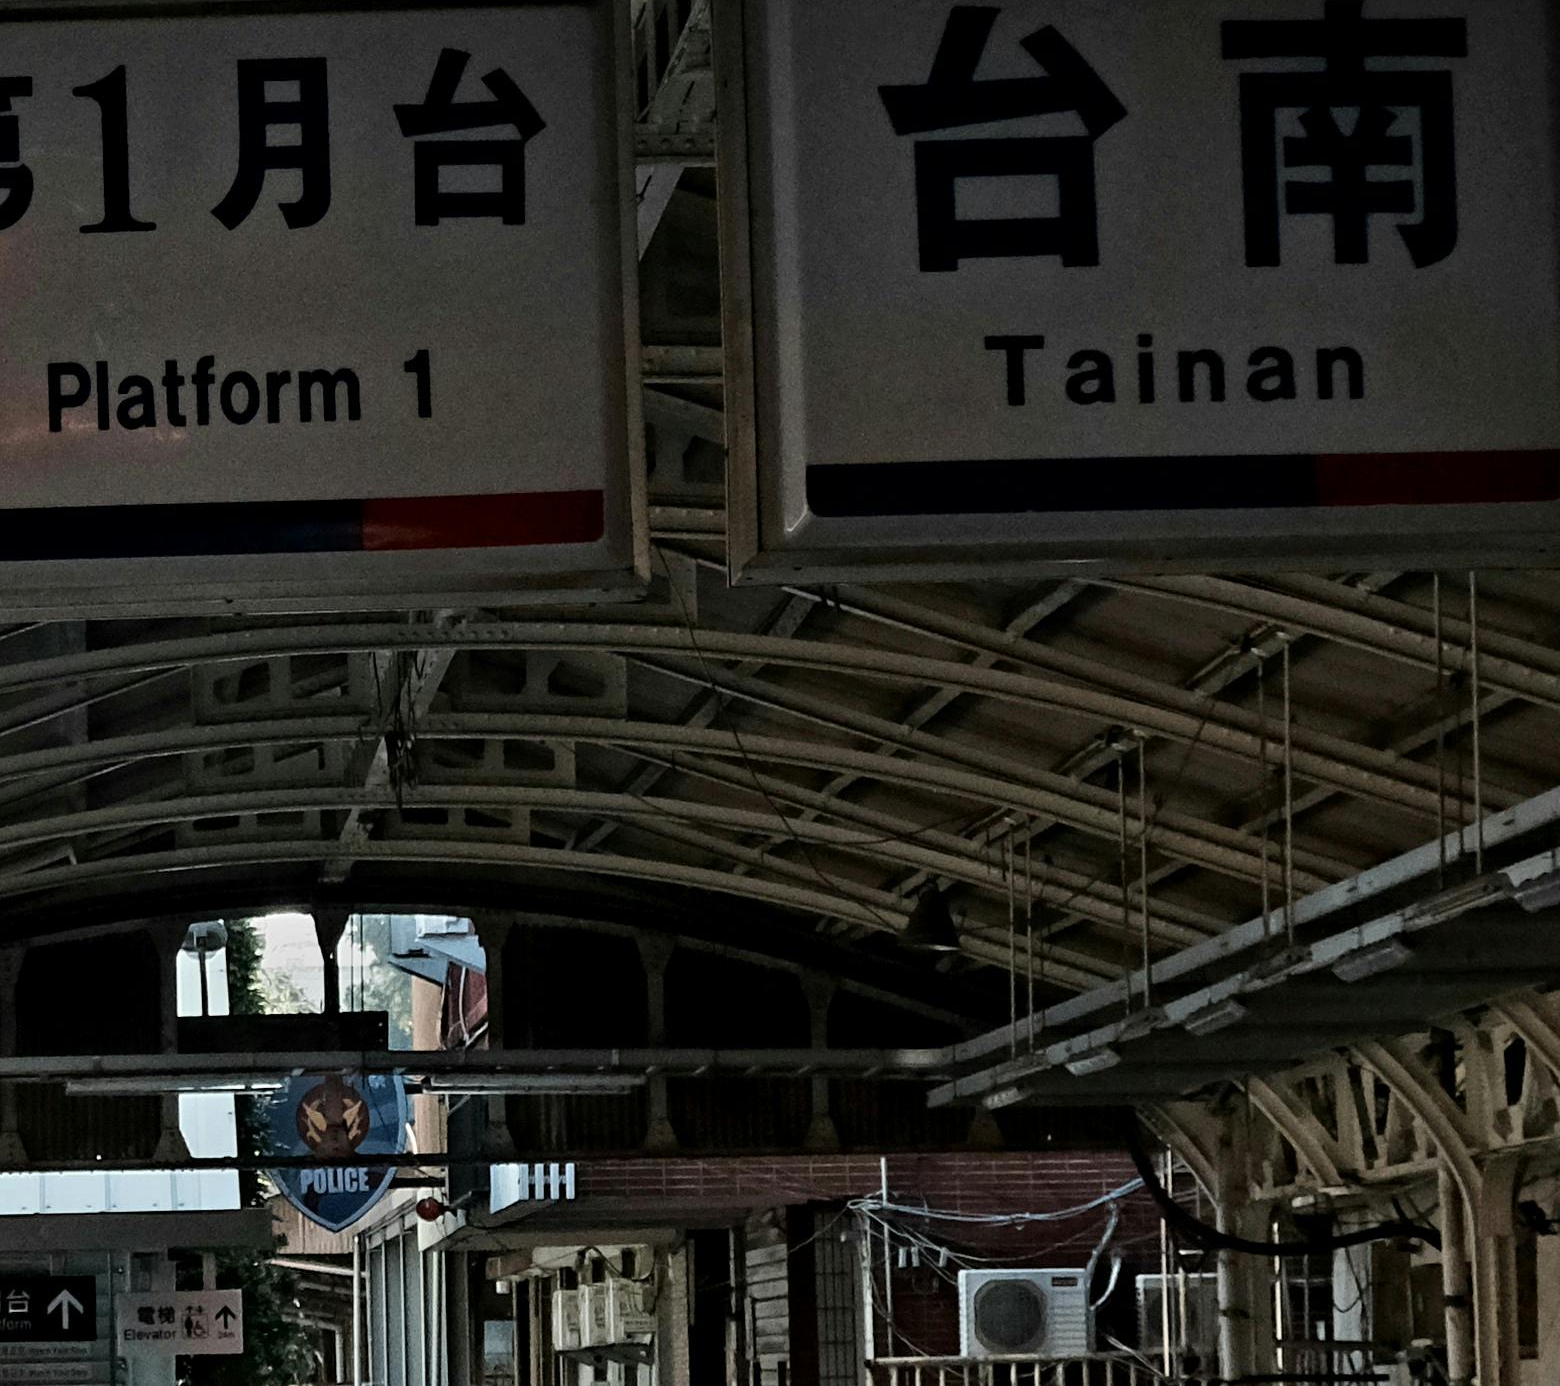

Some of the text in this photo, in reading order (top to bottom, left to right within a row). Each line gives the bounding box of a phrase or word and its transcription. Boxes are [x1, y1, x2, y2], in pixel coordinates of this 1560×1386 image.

[877, 0, 1470, 275] 台南
[47, 349, 433, 434] Platform 1
[984, 333, 1367, 411] Tainan
[300, 1167, 370, 1194] POLICE
[123, 1329, 176, 1341] Elevator
